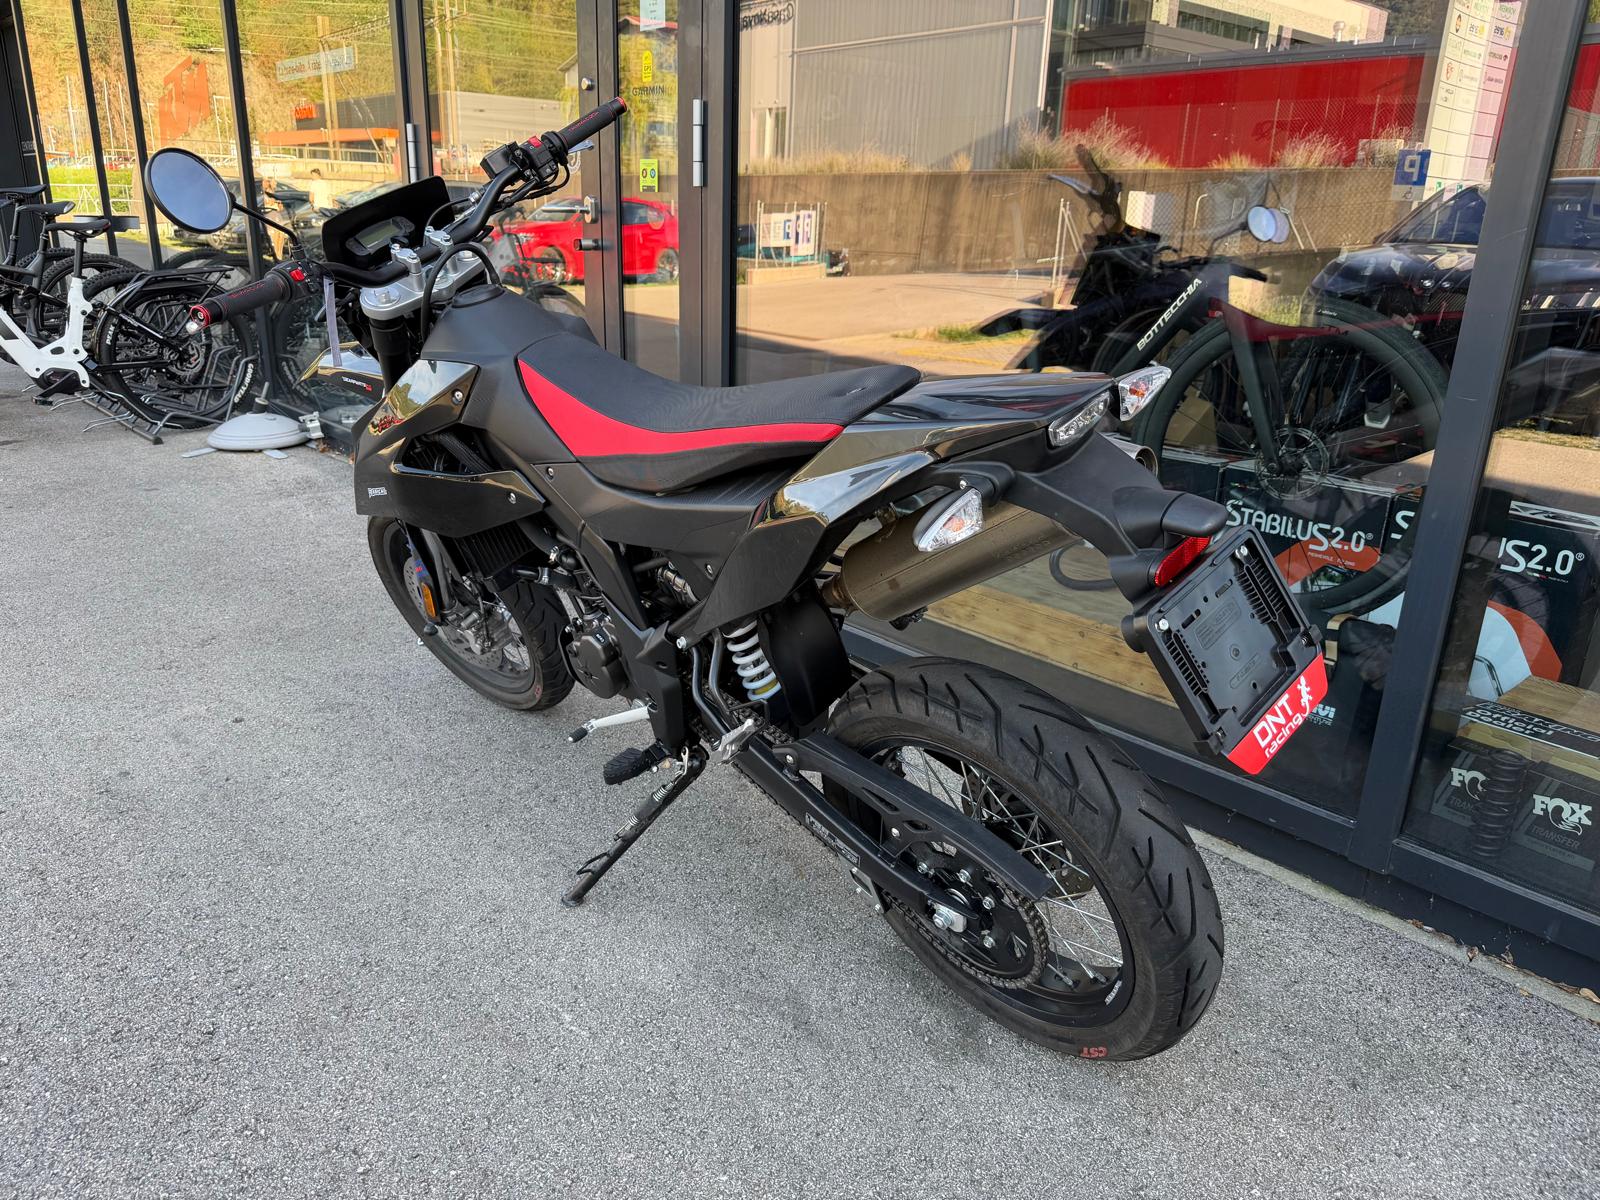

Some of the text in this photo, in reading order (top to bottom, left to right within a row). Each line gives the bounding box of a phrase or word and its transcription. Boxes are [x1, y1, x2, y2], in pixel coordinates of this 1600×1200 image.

[632, 85, 665, 97] GARMIN
[1136, 278, 1202, 351] BOTTECCHIA
[1252, 693, 1290, 748] DNT
[1264, 713, 1305, 758] racing
[1465, 711, 1535, 735] Dealer
[1476, 709, 1555, 736] Official
[1450, 767, 1488, 801] FO
[1532, 793, 1593, 835] FOX
